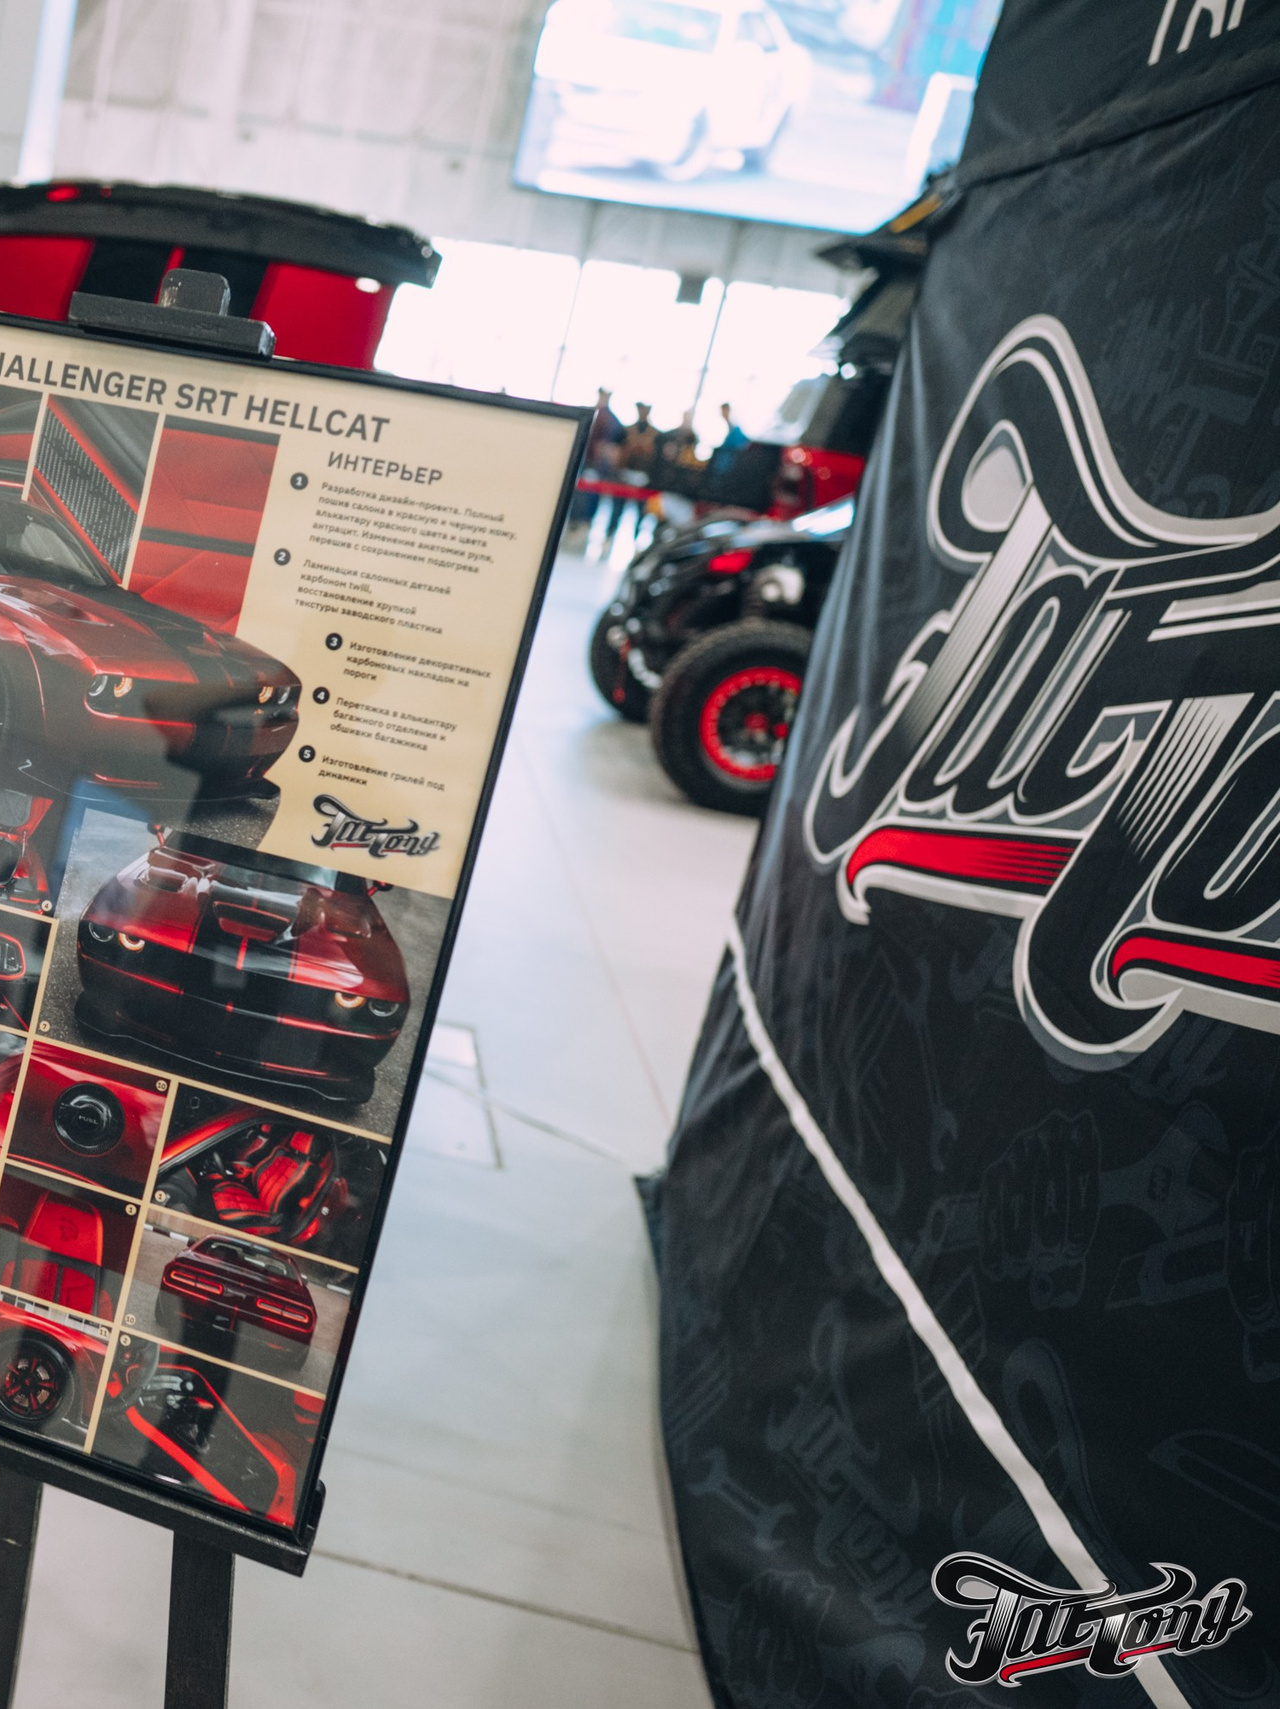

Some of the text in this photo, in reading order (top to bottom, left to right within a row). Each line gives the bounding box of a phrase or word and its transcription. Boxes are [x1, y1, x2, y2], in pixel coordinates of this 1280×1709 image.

[174, 382, 239, 416] SRT
[243, 394, 391, 443] HELLCAT
[327, 450, 443, 486] ИНТЕРЬЕР
[318, 496, 350, 508] пошив
[351, 502, 386, 515] салона
[387, 509, 394, 517] в
[395, 511, 439, 525] красную
[448, 521, 487, 534] черную
[320, 481, 377, 500] Разработка
[463, 507, 505, 523] Полный
[314, 509, 372, 527] алькантару
[372, 520, 418, 534] красного
[419, 529, 448, 540] цвета
[458, 536, 488, 548] цвета
[361, 530, 416, 548] Изменение
[417, 542, 466, 557] анатомии
[308, 534, 479, 574] перешив с сохранением подогрева
[299, 573, 347, 588] карбоном
[302, 558, 358, 577] Ламинация
[359, 571, 408, 587] салонных
[408, 581, 451, 595] деталей
[294, 598, 443, 635] текстуры заводского пластика
[297, 585, 417, 615] восстановление хрупкой
[342, 667, 378, 681] пороги
[346, 655, 470, 687] карбоновых накладок на
[349, 641, 417, 663] Изготовление
[417, 657, 491, 678] декоративных
[332, 709, 446, 742] багажного отделения и
[335, 696, 390, 716] Перетяжка
[391, 710, 398, 718] в
[399, 712, 458, 732] алькантару
[329, 722, 428, 751] обшивки багажника
[317, 769, 368, 786] динамики
[321, 755, 388, 778] Изготовление
[390, 772, 425, 786] грилей
[426, 780, 445, 792] под
